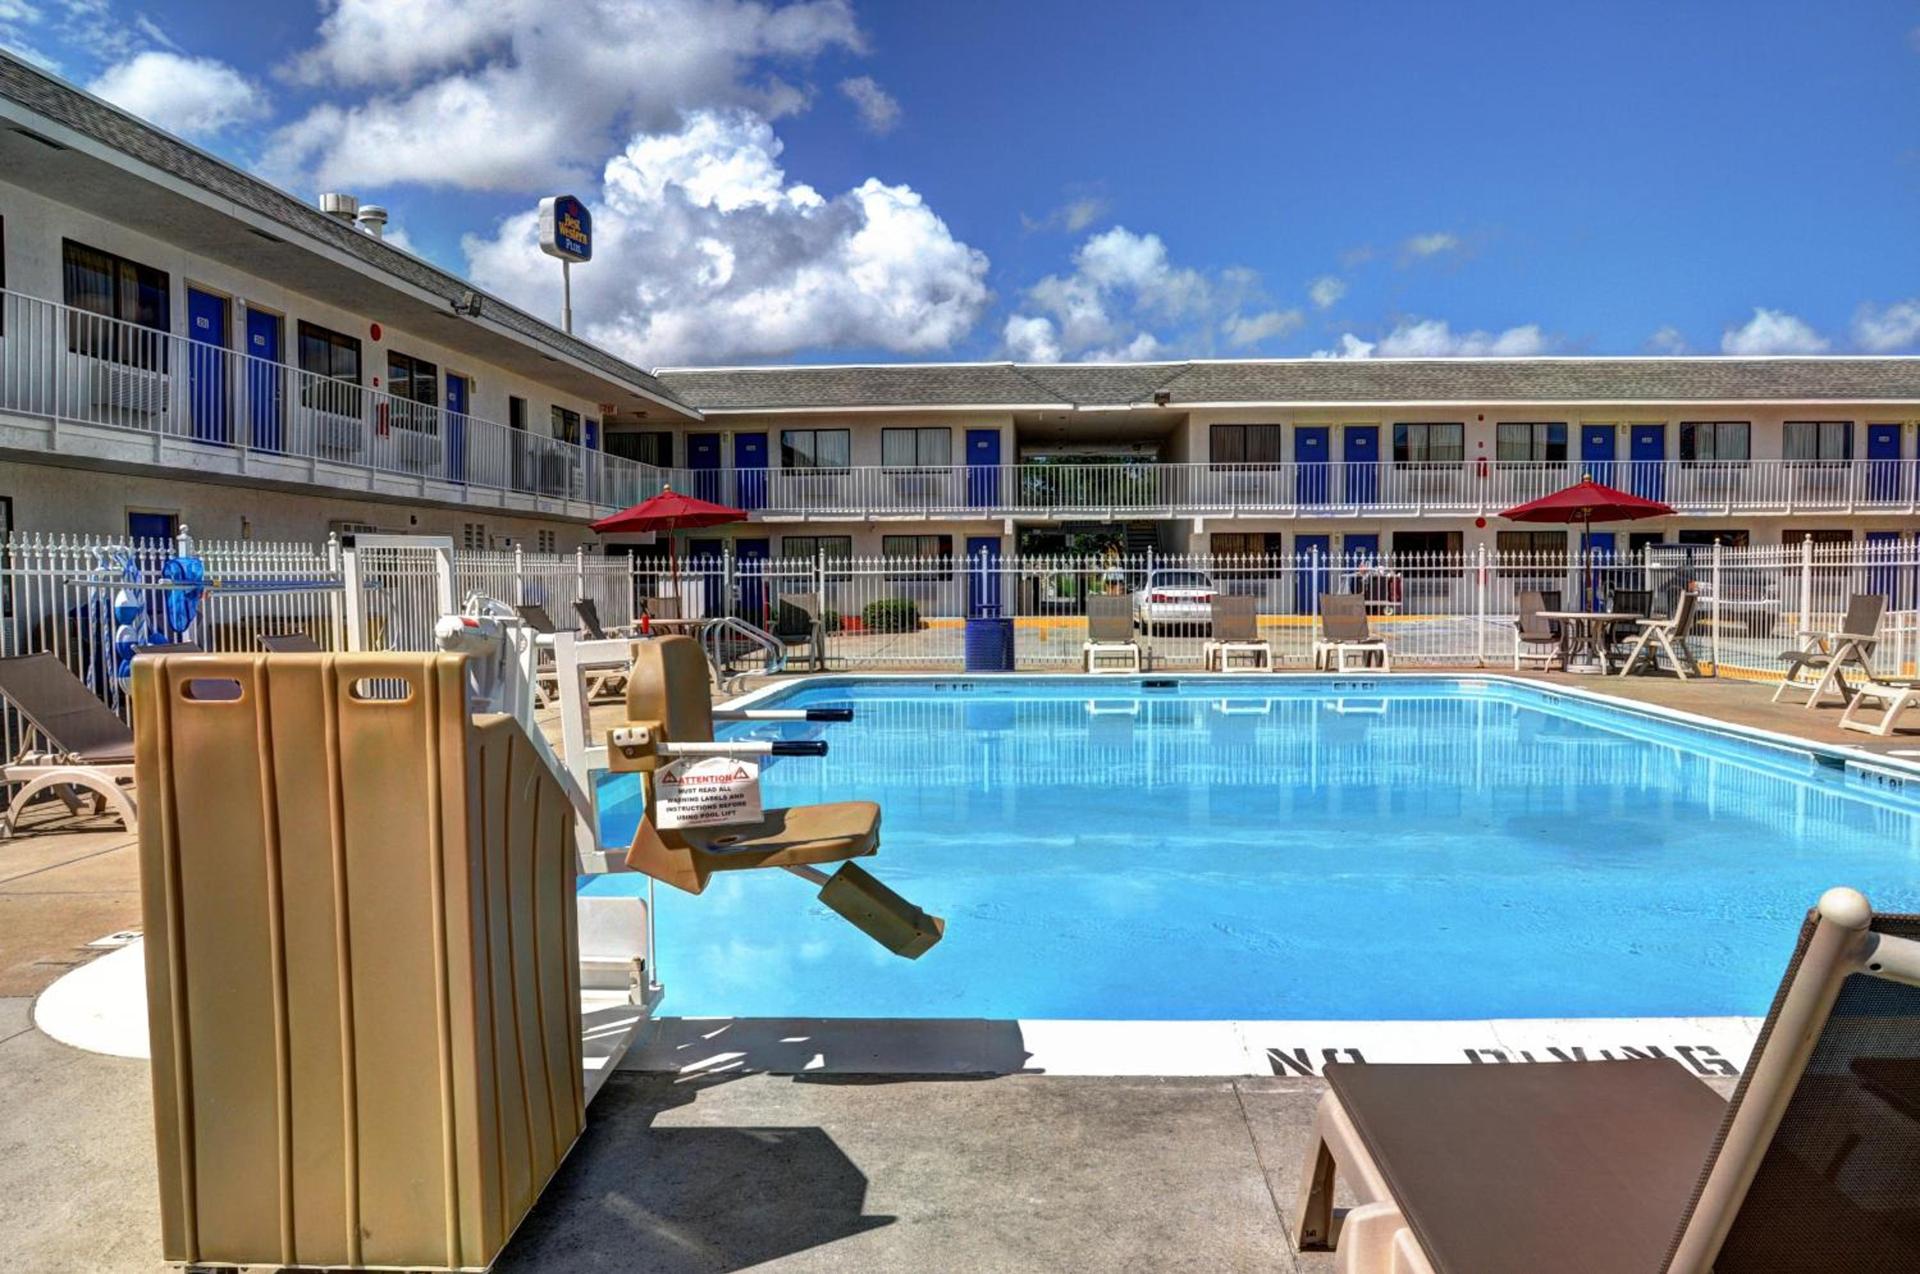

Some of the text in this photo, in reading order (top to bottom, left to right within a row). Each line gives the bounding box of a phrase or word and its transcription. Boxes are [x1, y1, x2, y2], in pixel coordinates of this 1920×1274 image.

[559, 221, 588, 245] Western
[678, 774, 732, 784] ATTENTION
[667, 796, 699, 804] WARNING
[666, 801, 747, 813] INSTRUCTIONS BEFORE
[676, 813, 699, 821] USING
[700, 812, 719, 820] POOL
